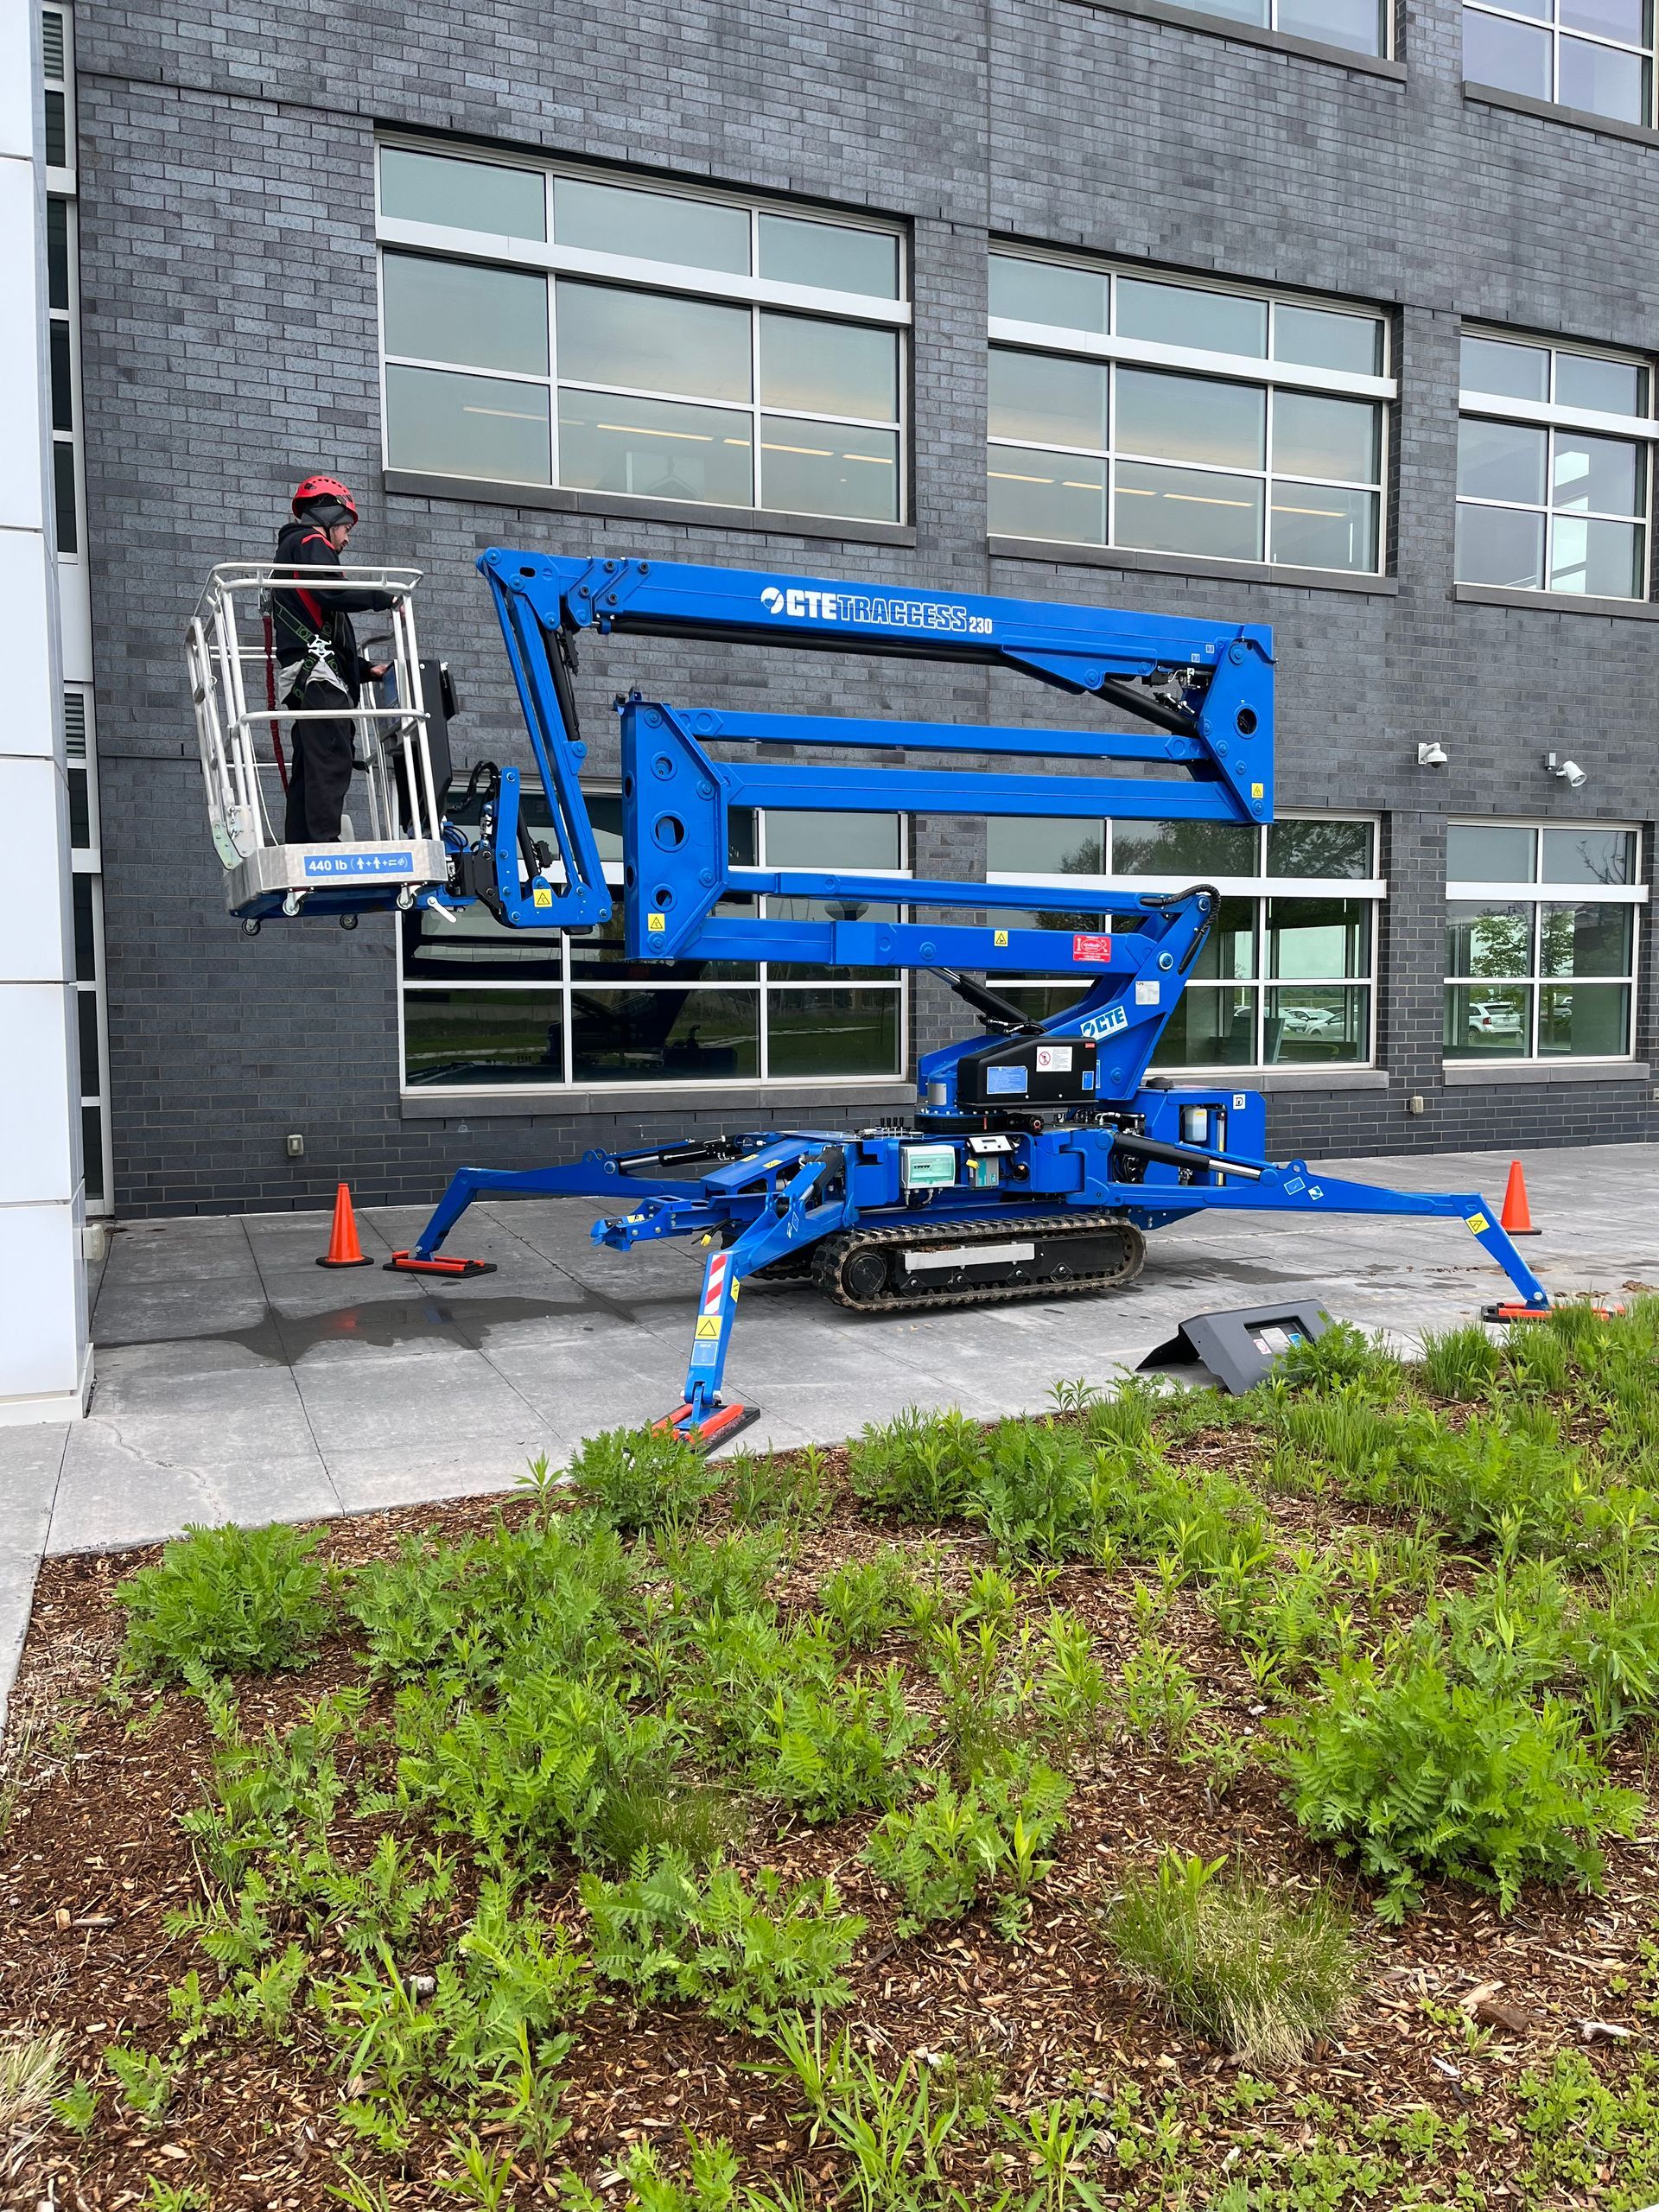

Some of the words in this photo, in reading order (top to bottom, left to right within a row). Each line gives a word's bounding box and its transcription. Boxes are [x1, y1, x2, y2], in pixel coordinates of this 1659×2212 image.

[969, 616, 993, 634] 230
[308, 860, 332, 871] 440
[334, 859, 348, 871] lb
[1095, 1007, 1125, 1033] CTE
